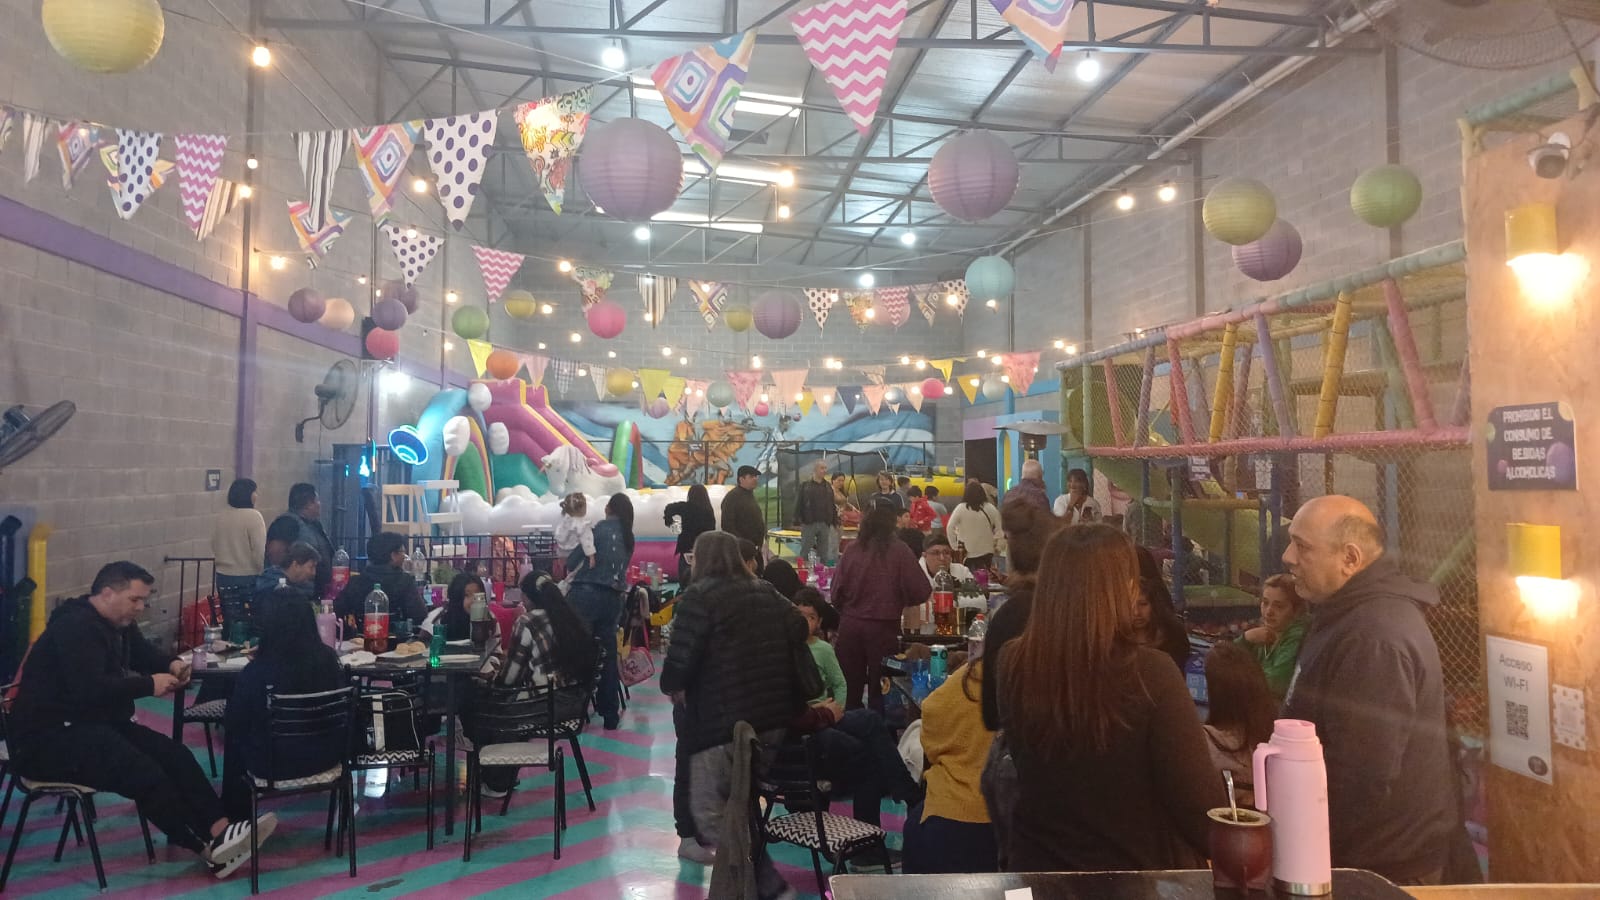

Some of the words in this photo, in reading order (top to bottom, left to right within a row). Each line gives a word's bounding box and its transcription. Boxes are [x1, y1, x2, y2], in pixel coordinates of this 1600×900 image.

[1503, 409, 1541, 423] PROHIBIDO
[1542, 407, 1554, 420] EL
[1503, 428, 1540, 442] CONSUMO
[1541, 427, 1554, 440] DE
[1512, 447, 1546, 461] BEBIDAS
[1499, 653, 1532, 672] Acceso
